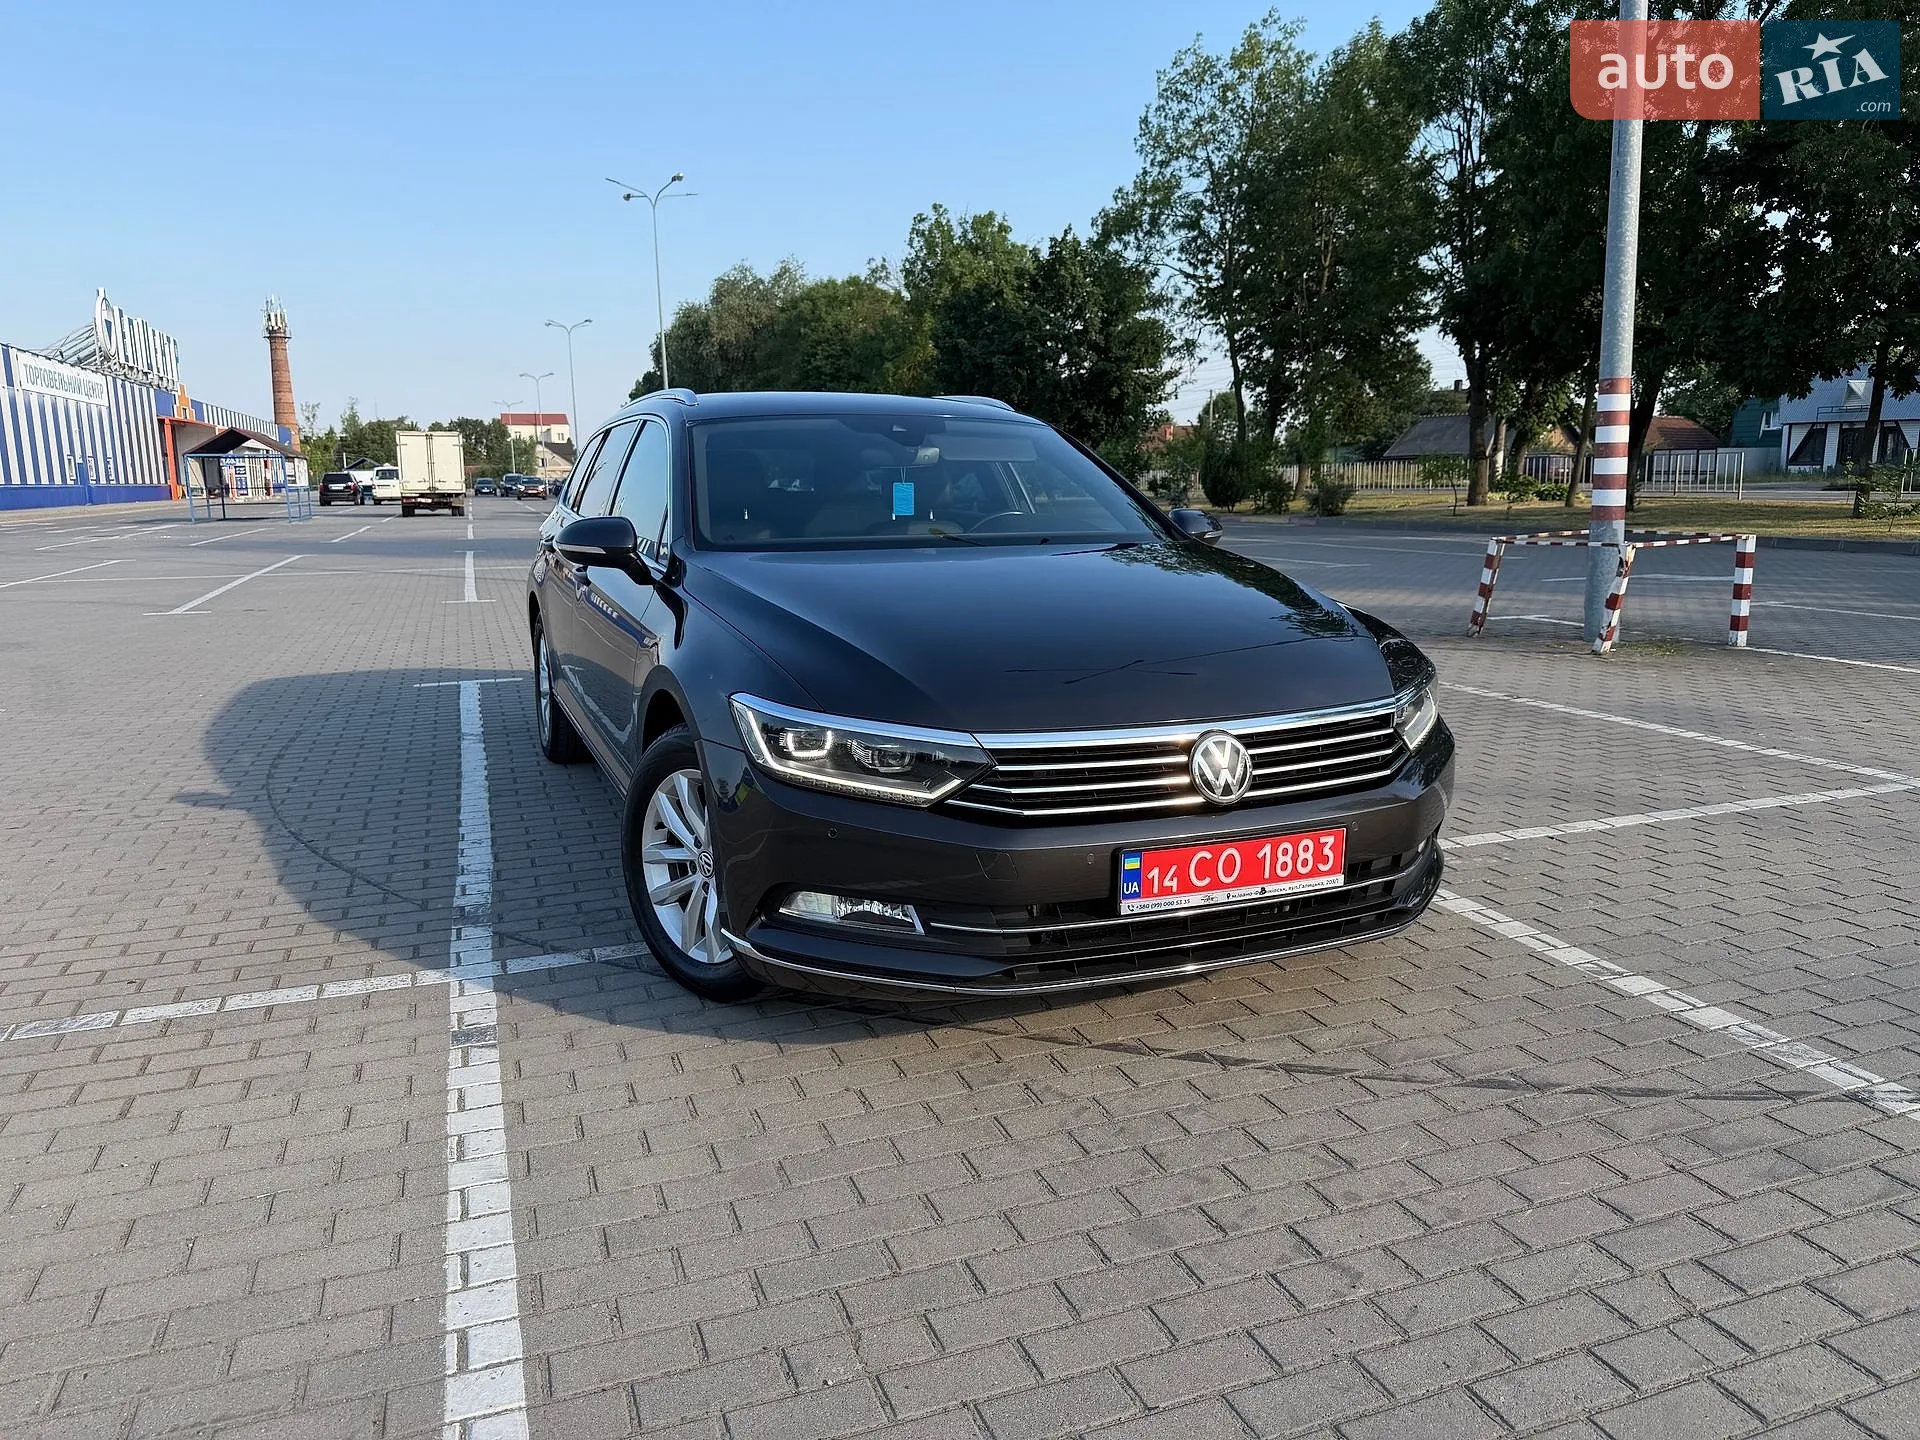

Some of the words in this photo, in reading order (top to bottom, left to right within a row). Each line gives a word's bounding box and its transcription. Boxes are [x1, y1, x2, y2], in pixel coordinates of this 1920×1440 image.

[22, 363, 84, 396] ТОРГОВЕЛЬНИЙ
[82, 377, 104, 401] ЦЕНТР
[1146, 864, 1178, 895] 14
[1188, 847, 1242, 888] CO
[1256, 835, 1335, 880] 1883
[1123, 881, 1140, 895] UA
